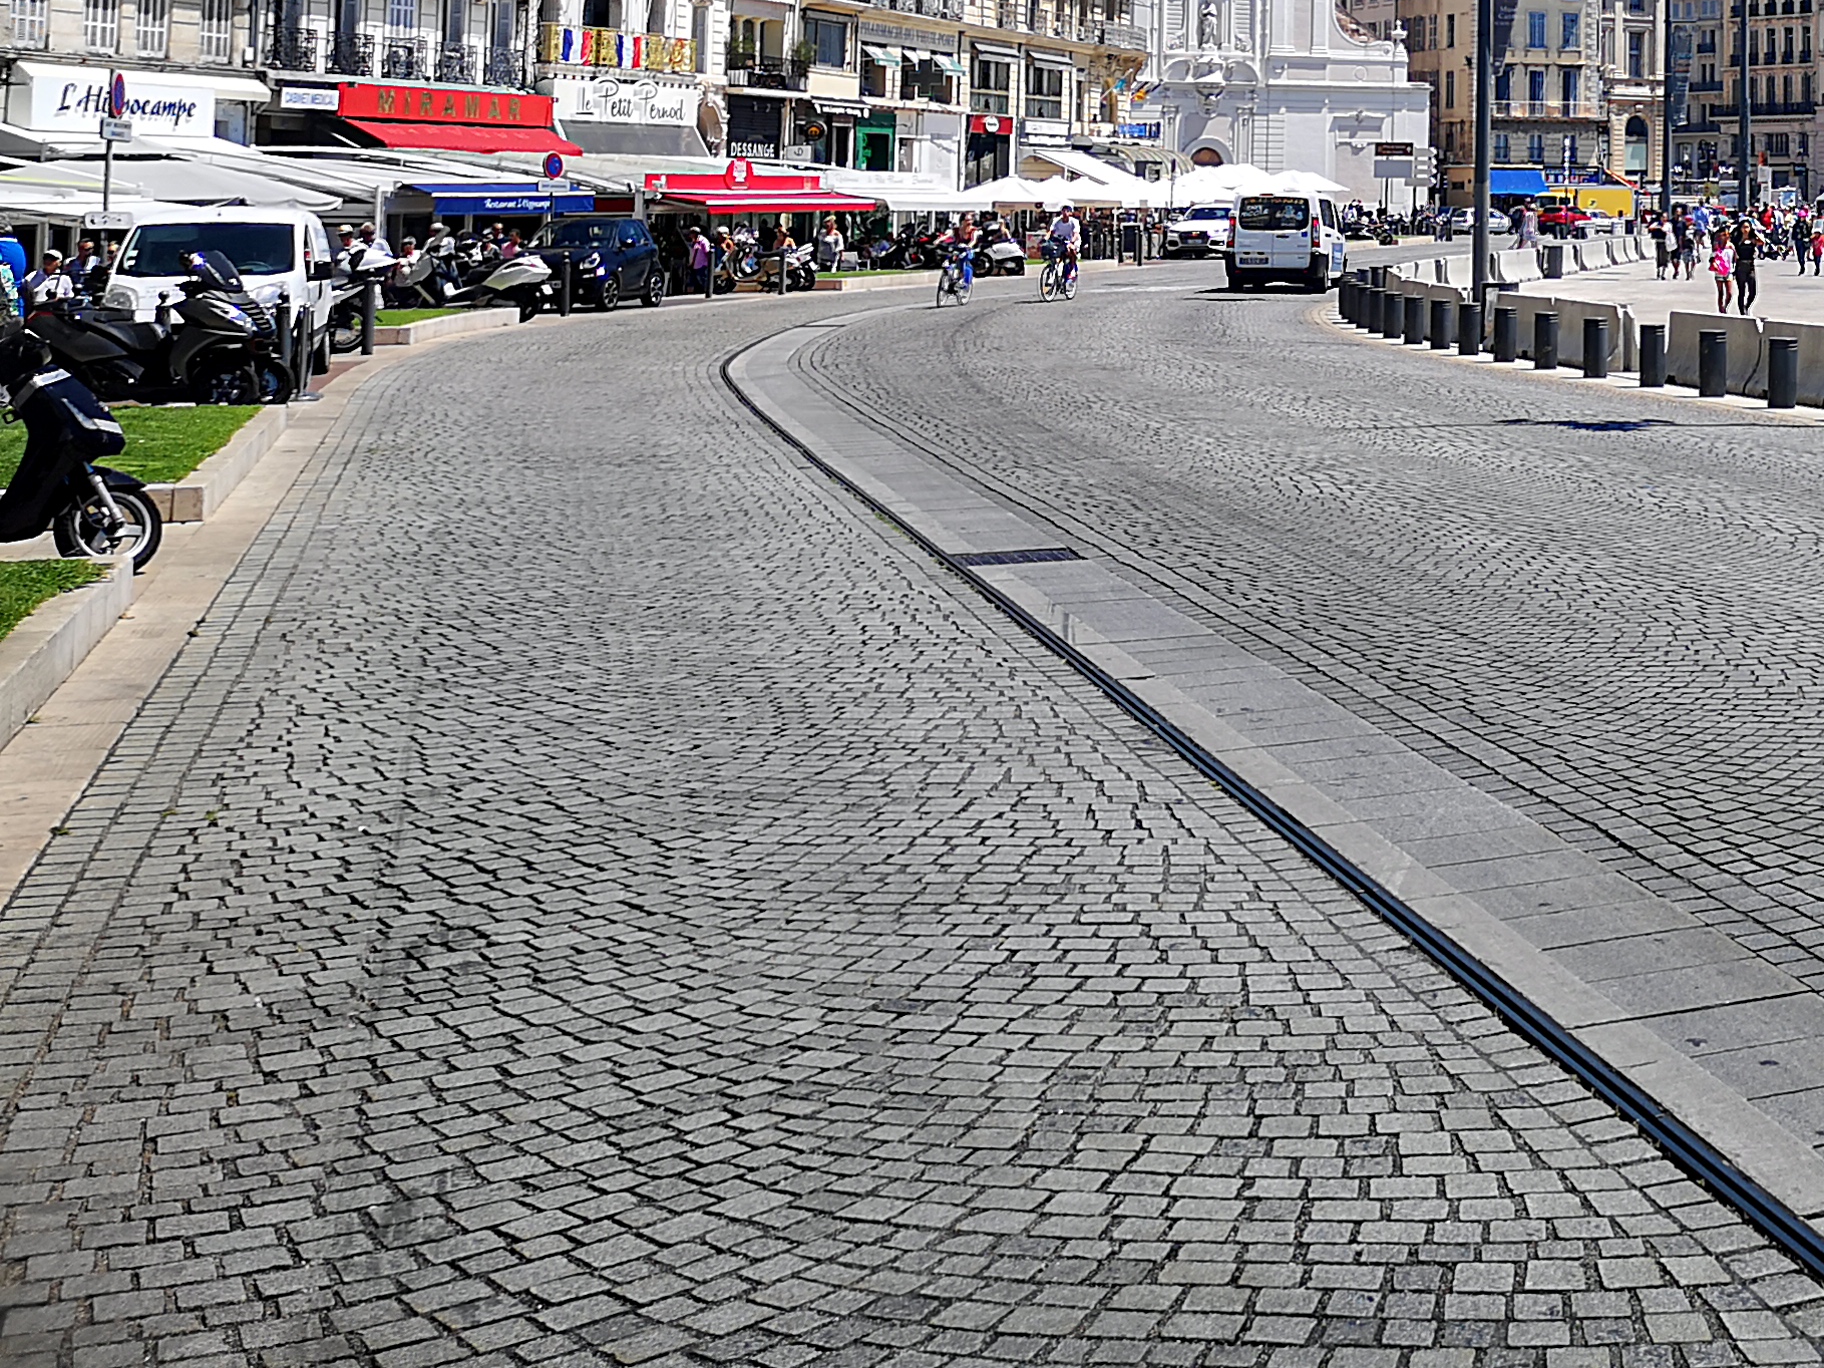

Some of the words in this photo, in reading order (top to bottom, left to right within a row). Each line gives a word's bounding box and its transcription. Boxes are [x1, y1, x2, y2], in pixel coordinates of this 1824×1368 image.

[56, 83, 197, 127] L'Hiocampe
[377, 88, 522, 121] MIRAMAR
[598, 79, 633, 118] Petit
[638, 82, 686, 122] Pernod
[730, 141, 775, 158] DESSANGE
